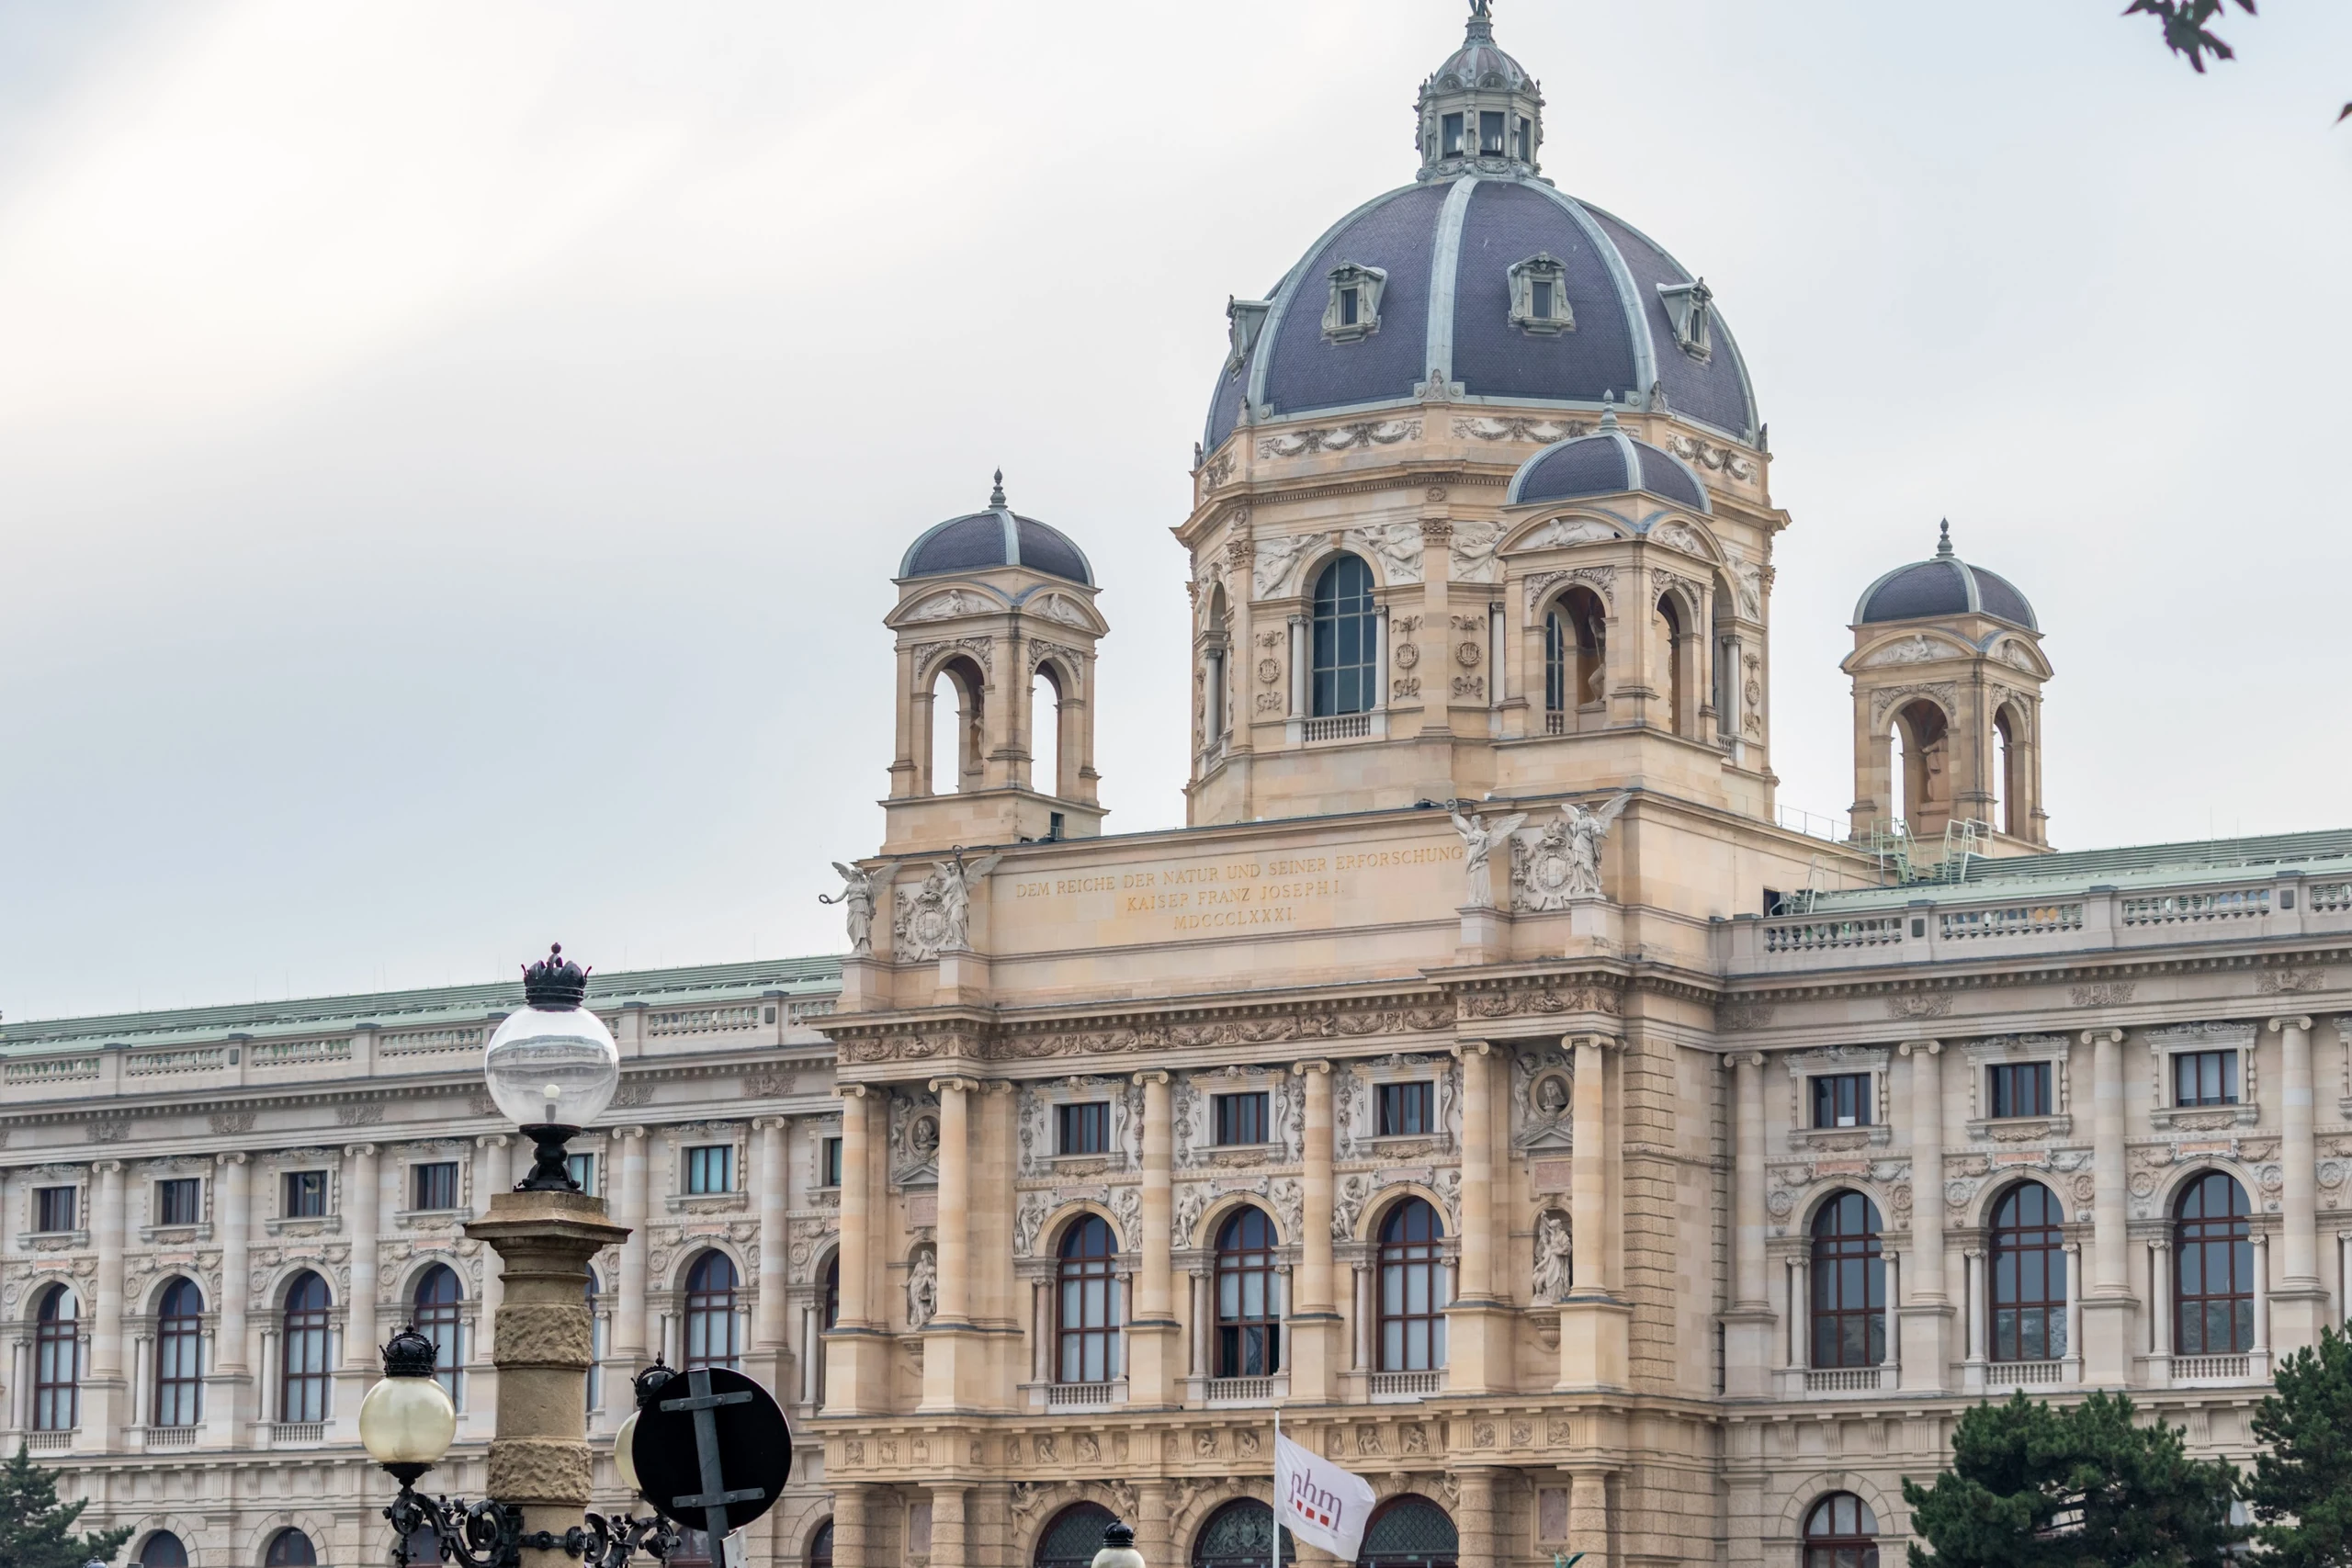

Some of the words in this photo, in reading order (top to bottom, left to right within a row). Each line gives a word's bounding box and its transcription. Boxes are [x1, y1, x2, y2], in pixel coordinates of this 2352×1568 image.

[1016, 883, 1049, 897] DEM
[1057, 876, 1115, 894] REICHE
[1124, 873, 1156, 889] DER
[1163, 867, 1218, 886] NATUR
[1227, 863, 1261, 880] UND
[1268, 857, 1327, 877] SEINER
[1336, 846, 1464, 871] ERFORSCHUNG
[1198, 887, 1250, 906] FRANZ
[1260, 881, 1329, 901] JOSEPH
[1288, 1469, 1342, 1532] nhm
